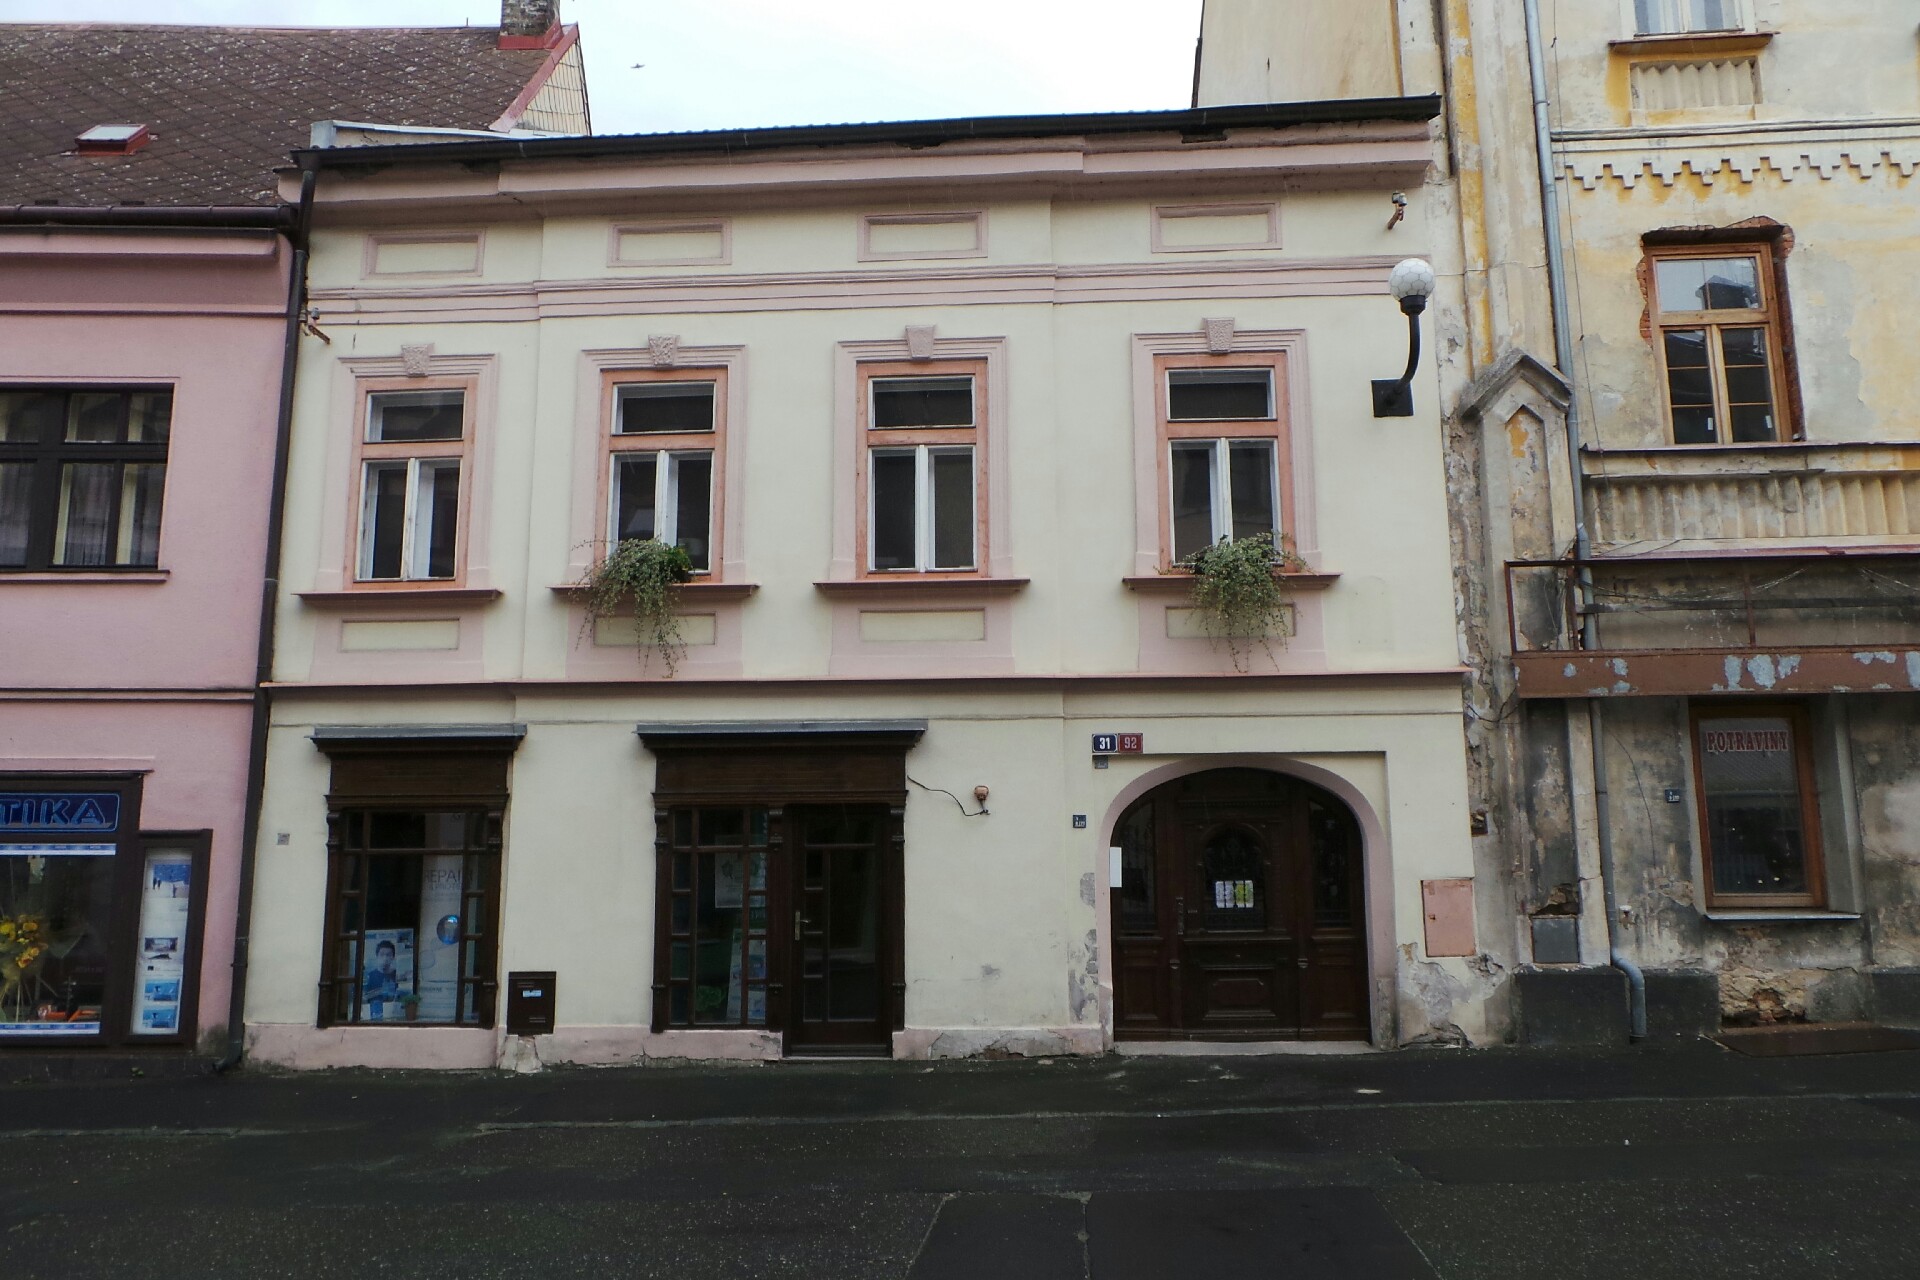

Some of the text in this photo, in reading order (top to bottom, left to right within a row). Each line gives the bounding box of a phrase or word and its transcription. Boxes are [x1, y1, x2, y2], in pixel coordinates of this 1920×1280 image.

[1099, 737, 1111, 750] 31
[1124, 736, 1137, 749] 92
[1706, 730, 1788, 752] POTRAVINY
